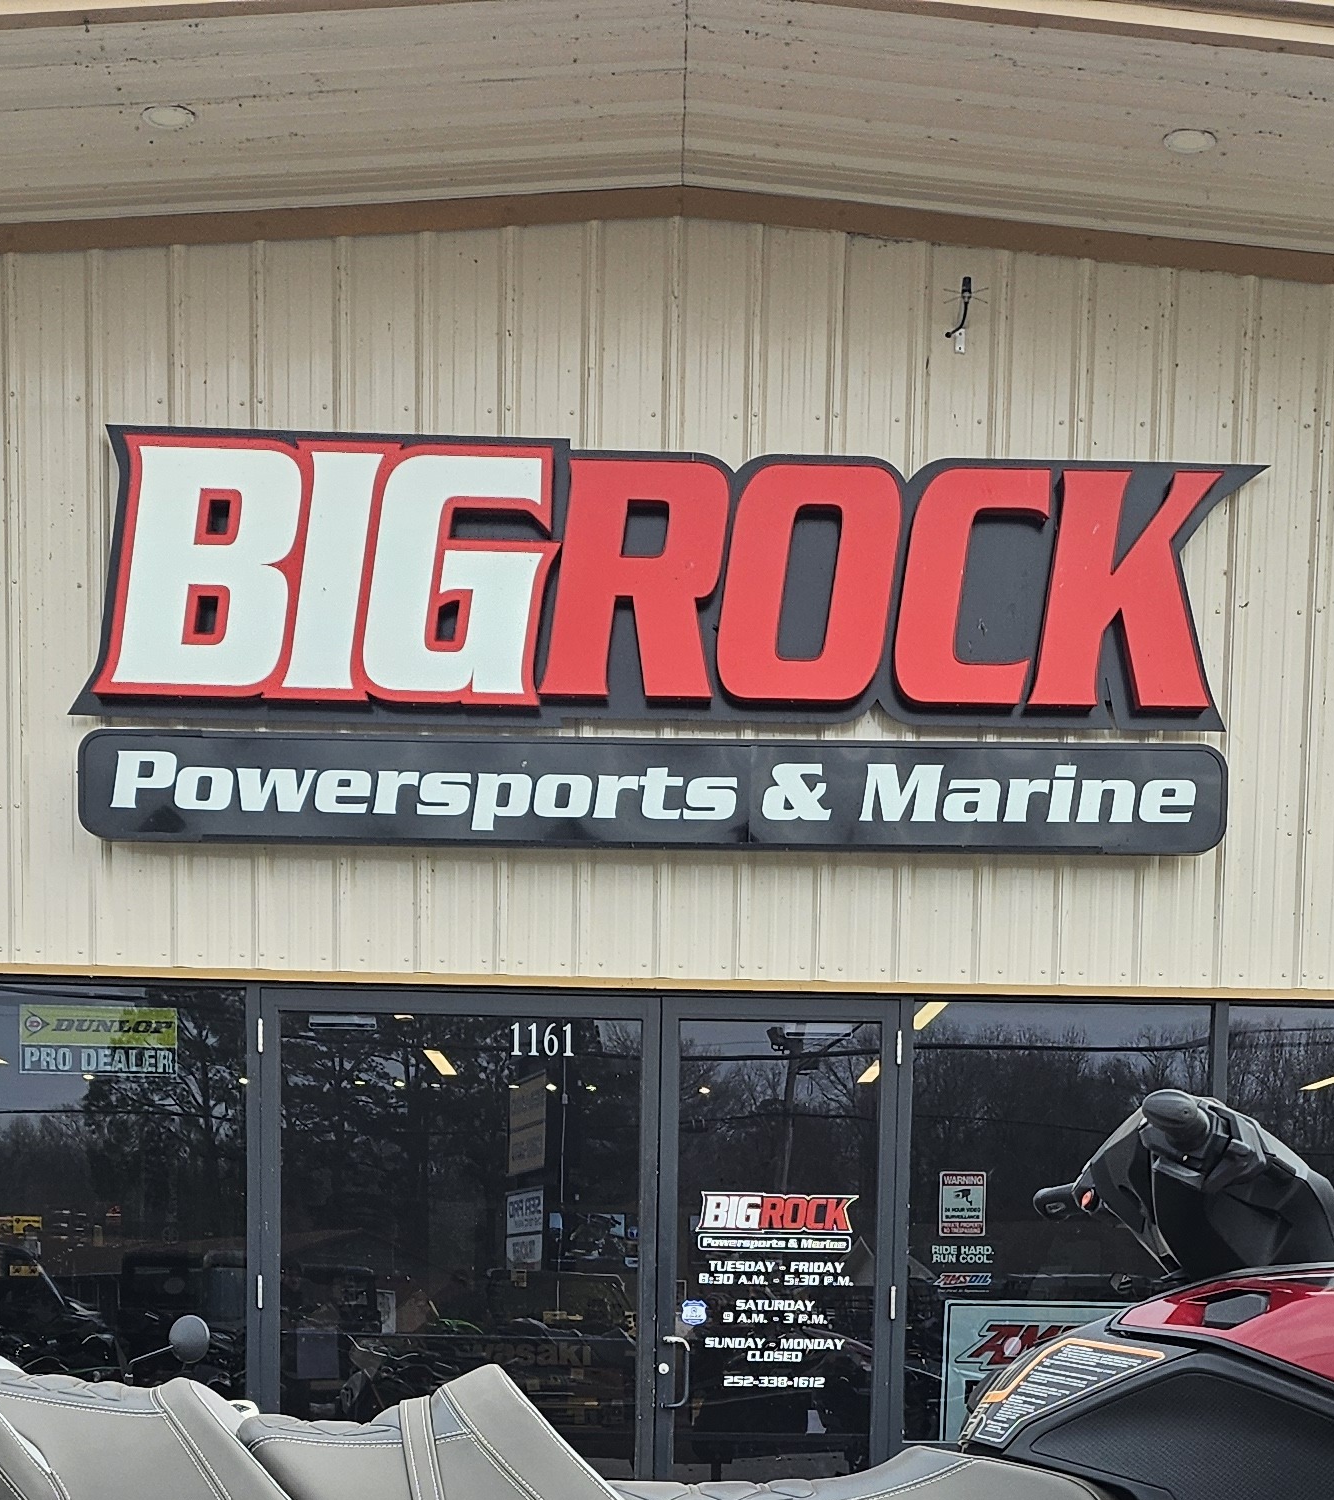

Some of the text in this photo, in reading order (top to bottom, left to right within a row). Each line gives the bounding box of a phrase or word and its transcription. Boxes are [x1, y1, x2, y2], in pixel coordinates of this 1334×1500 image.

[110, 750, 1196, 831] Powersports & Marine
[51, 1018, 174, 1034] DUNLOP
[510, 1022, 575, 1057] 1161
[24, 1047, 174, 1073] PRO DEALER
[943, 1175, 983, 1185] WARNING
[702, 1237, 847, 1249] Powersports & Marine
[931, 1245, 995, 1255] RIDE HARD.
[932, 1254, 994, 1263] RUN COOL.
[708, 1260, 776, 1272] TUESDAY
[789, 1261, 845, 1273] FRIDAY
[698, 1273, 734, 1285] 8:30
[737, 1274, 768, 1285] A.M.
[783, 1274, 820, 1286] 5:30
[823, 1275, 854, 1286] P.M.
[935, 1273, 991, 1287] AMSOIL
[735, 1299, 815, 1312] SATURDAY
[722, 1311, 734, 1323] 9
[737, 1312, 768, 1324] A.M.
[783, 1312, 795, 1324] 3
[797, 1313, 828, 1325] P.M.
[704, 1337, 766, 1349] SUNDAY
[779, 1338, 845, 1350] MONDAY
[746, 1350, 803, 1363] CLOSED
[723, 1375, 825, 1389] 252-338-1612
